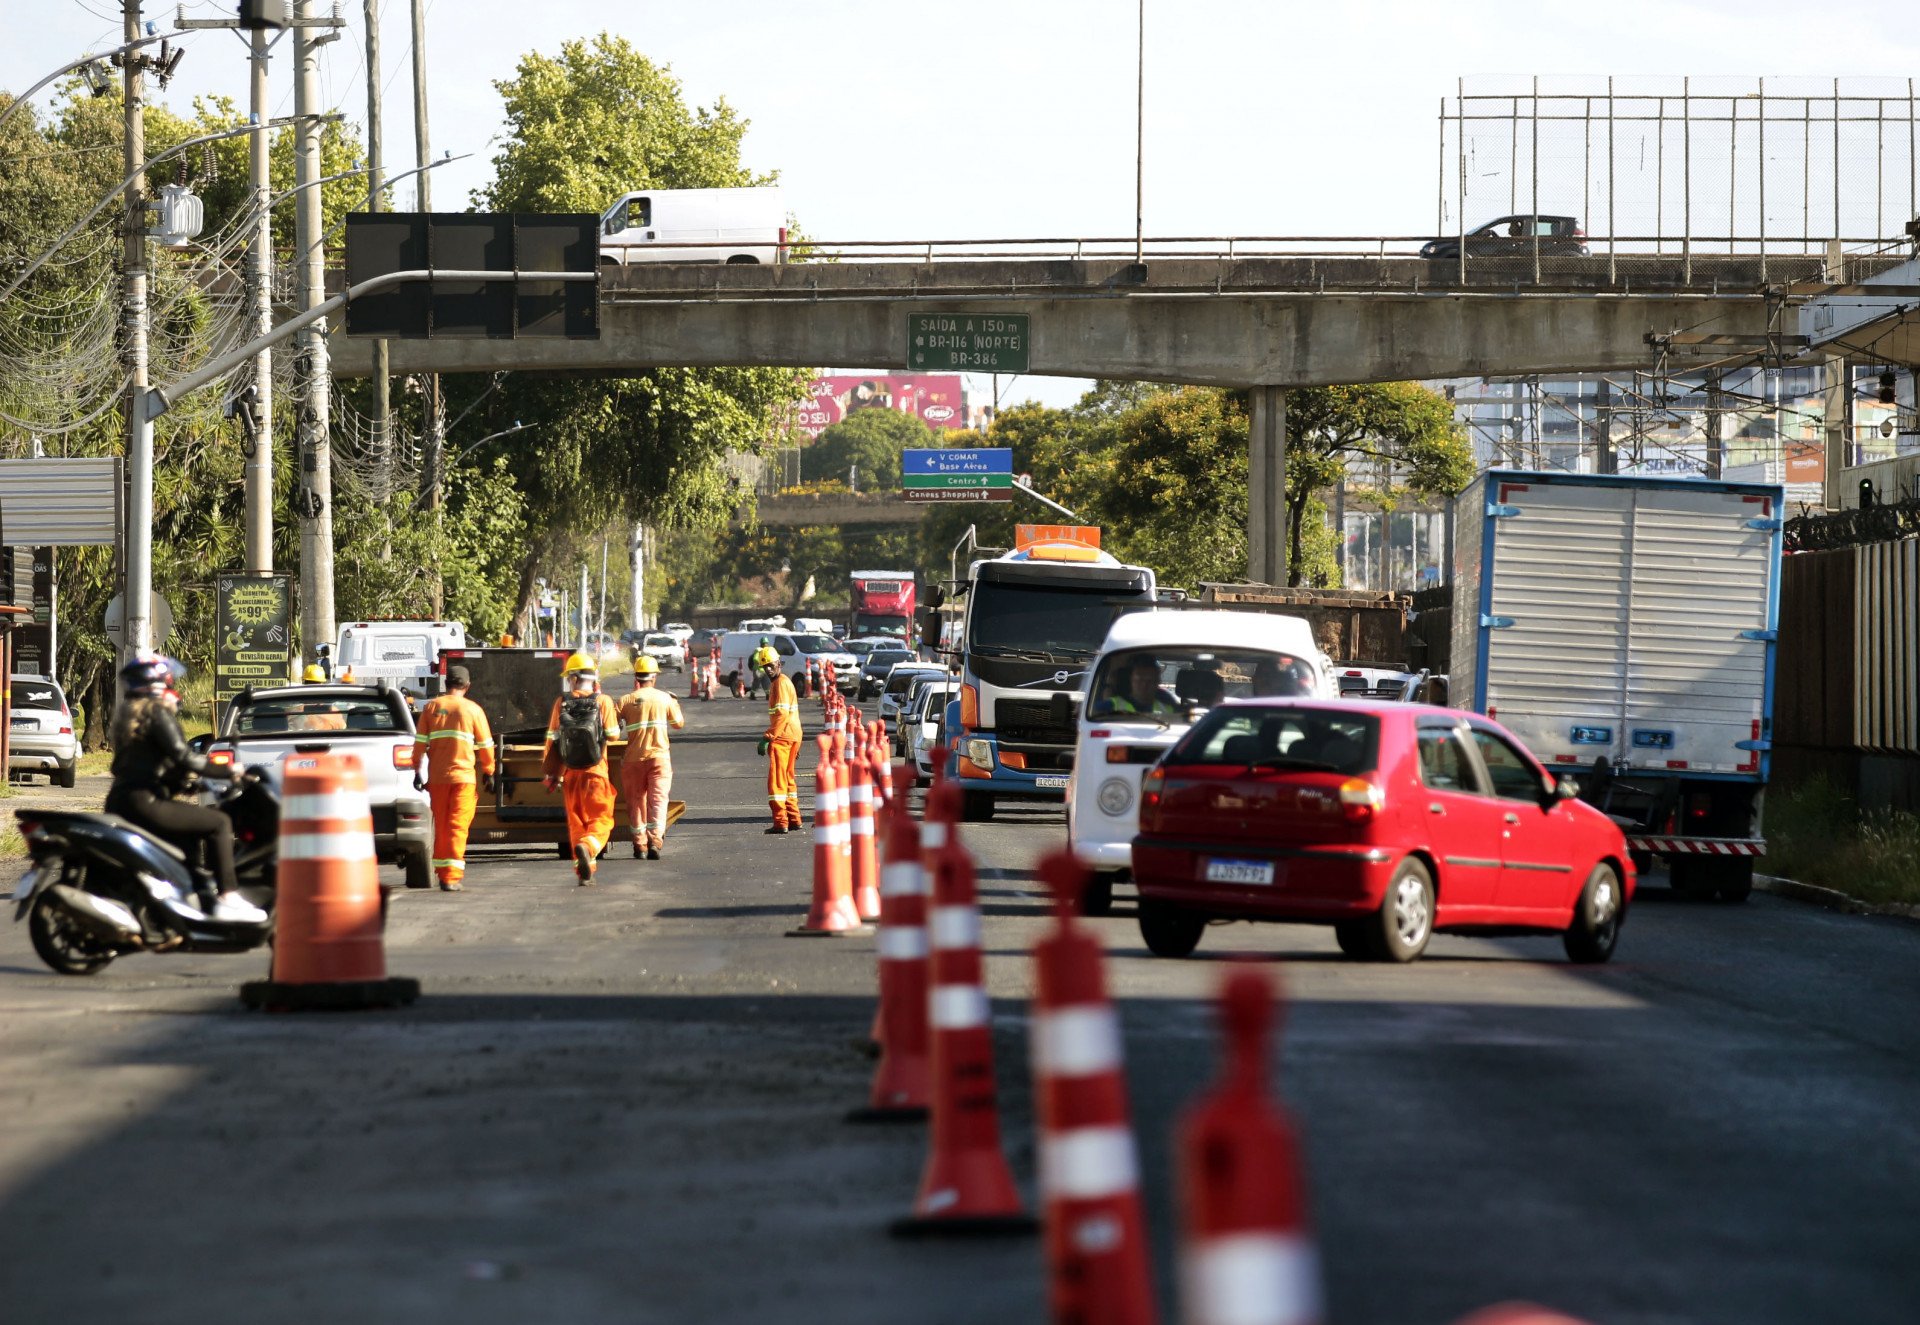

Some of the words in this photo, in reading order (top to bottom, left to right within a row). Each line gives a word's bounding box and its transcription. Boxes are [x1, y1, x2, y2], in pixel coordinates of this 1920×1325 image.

[920, 316, 957, 332] SAÍDA
[966, 320, 974, 332] A
[982, 320, 1005, 332] 150
[1008, 323, 1018, 332] m
[929, 335, 967, 348] BR-116
[974, 334, 1021, 351] (NORTE)
[951, 352, 998, 365] BR-386
[948, 453, 978, 461] COMAR
[939, 462, 960, 471] Base
[947, 477, 977, 485] Centro
[942, 490, 980, 500] Shopping
